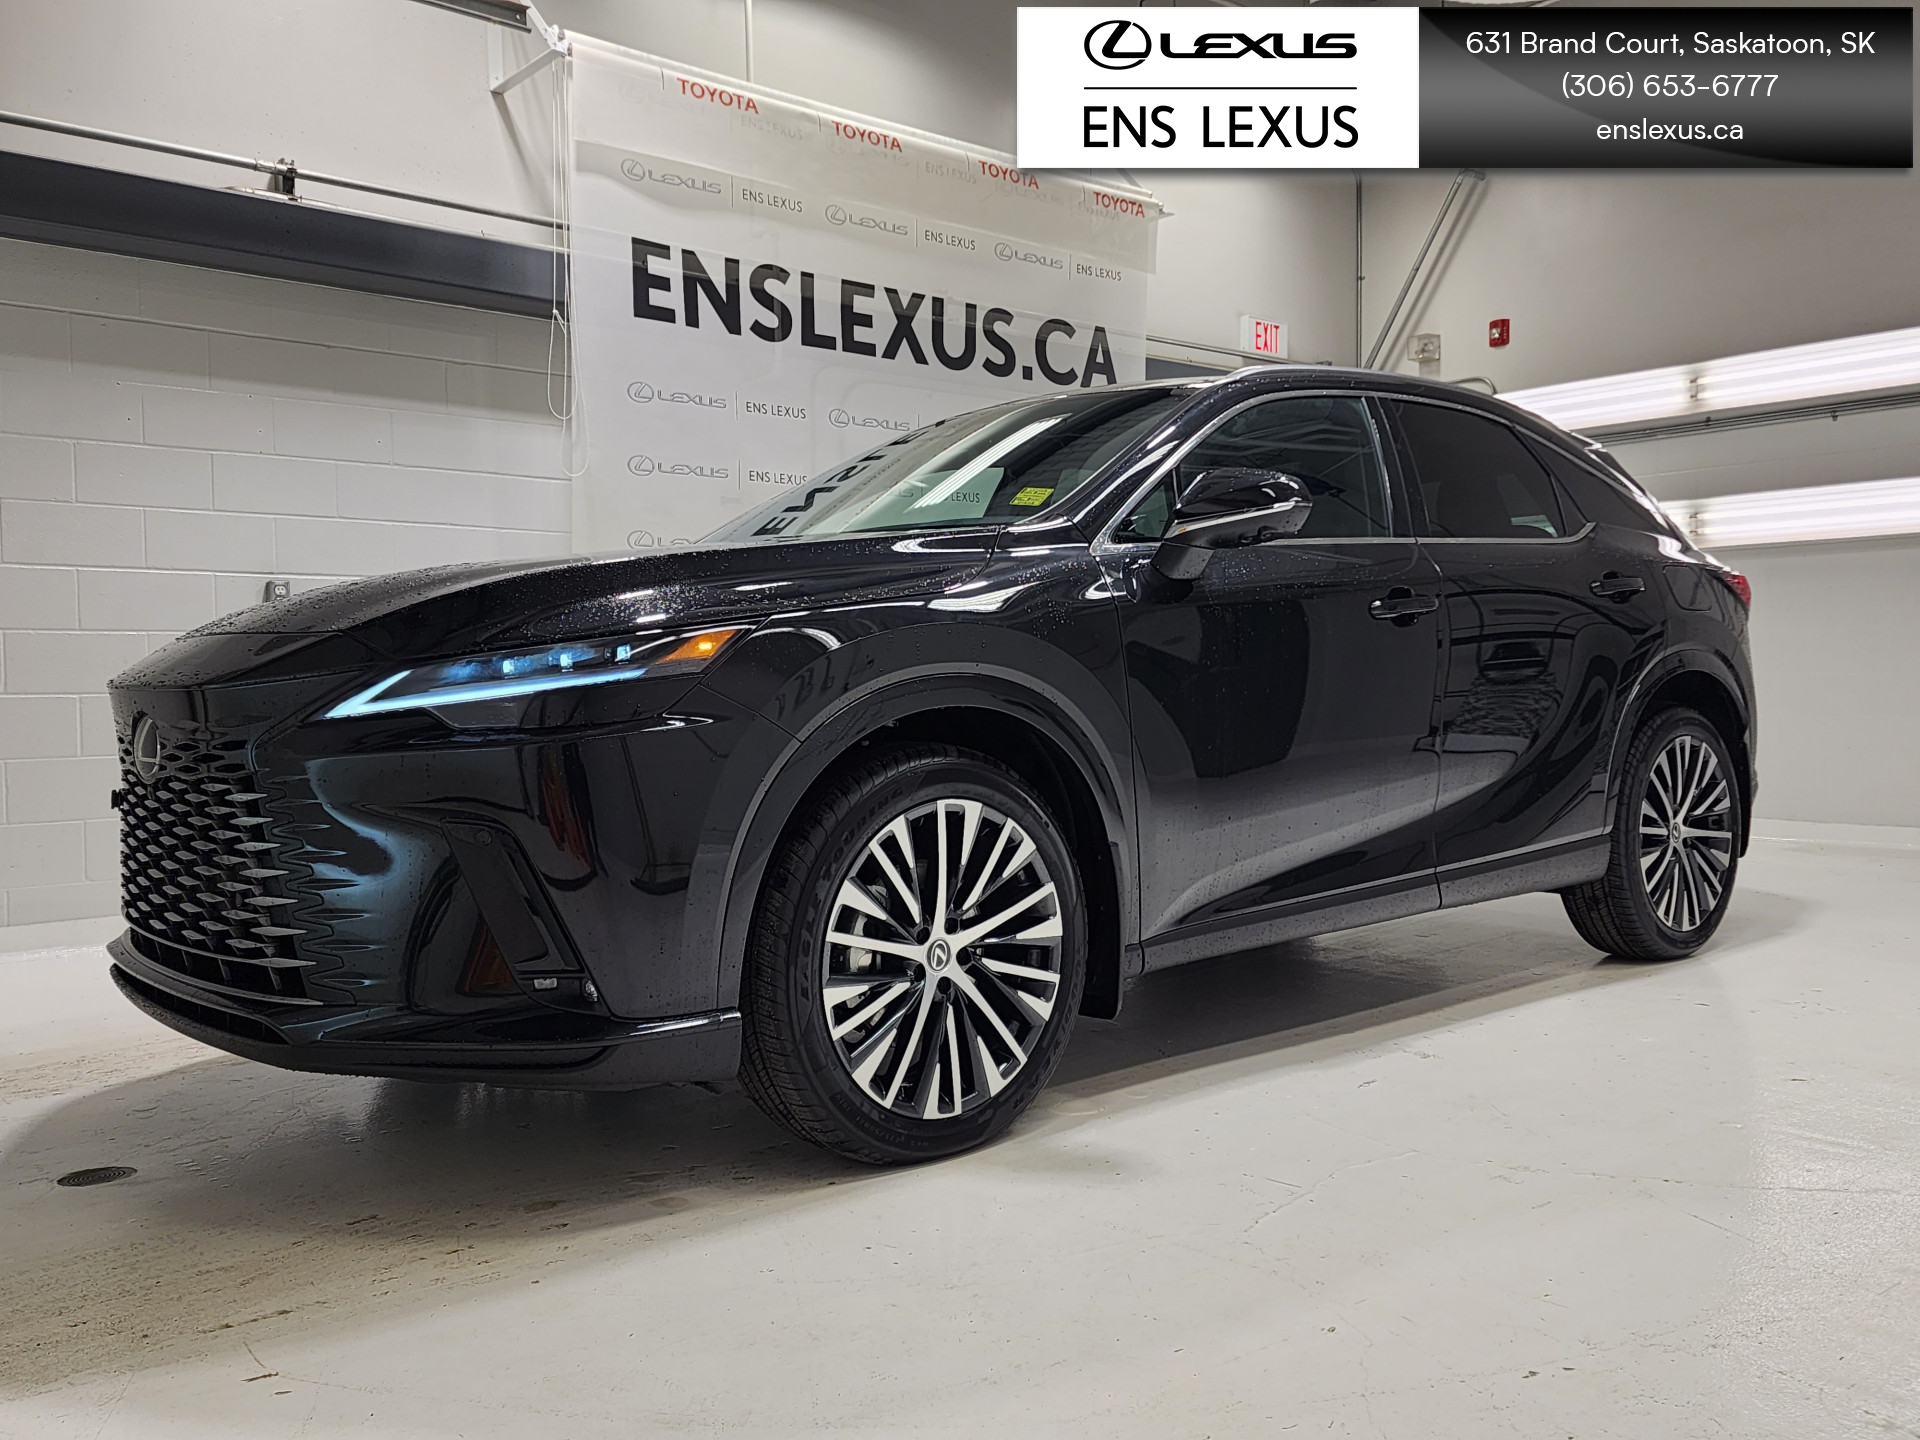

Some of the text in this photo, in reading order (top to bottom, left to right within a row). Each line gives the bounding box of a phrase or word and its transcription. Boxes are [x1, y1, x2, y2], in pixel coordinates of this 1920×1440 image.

[677, 77, 760, 115] TOYOTA
[831, 120, 903, 153] TOYOTA
[647, 168, 804, 213] LEXUS ENS LEXUS
[978, 160, 1040, 190] TOYOTA
[1093, 191, 1146, 219] TOYOTA
[848, 213, 976, 251] LEXUS ENS LEXUS
[1014, 250, 1122, 282] LEXUS ENS LEXUS
[631, 236, 1118, 389] ENSLEXUS.CA
[1255, 321, 1280, 354] EXIT
[657, 389, 807, 420] LEXUS ENS LEXUS
[851, 414, 910, 432] LEXUS
[657, 461, 808, 486] LEXUS ENS LEXUS
[950, 492, 980, 504] LEXUS
